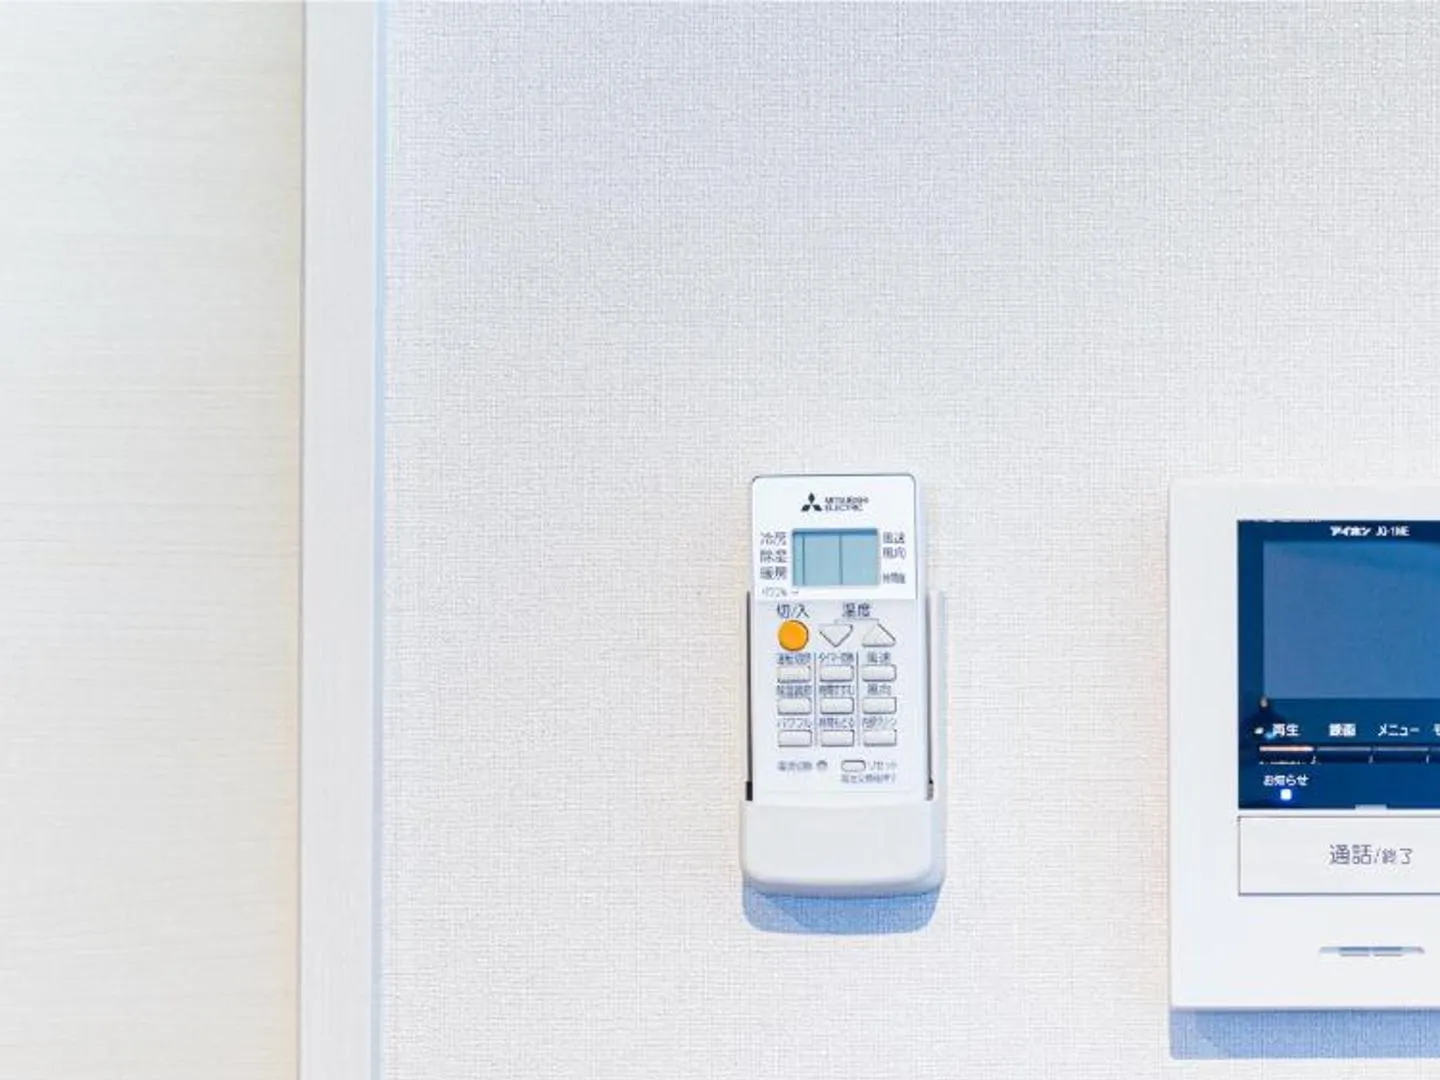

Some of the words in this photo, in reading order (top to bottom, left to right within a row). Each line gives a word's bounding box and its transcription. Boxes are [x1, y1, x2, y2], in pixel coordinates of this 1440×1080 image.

[1330, 525, 1371, 537] アイホン
[1272, 723, 1299, 736] 再生
[1378, 723, 1420, 736] メニュー
[1263, 774, 1309, 786] お知らせ
